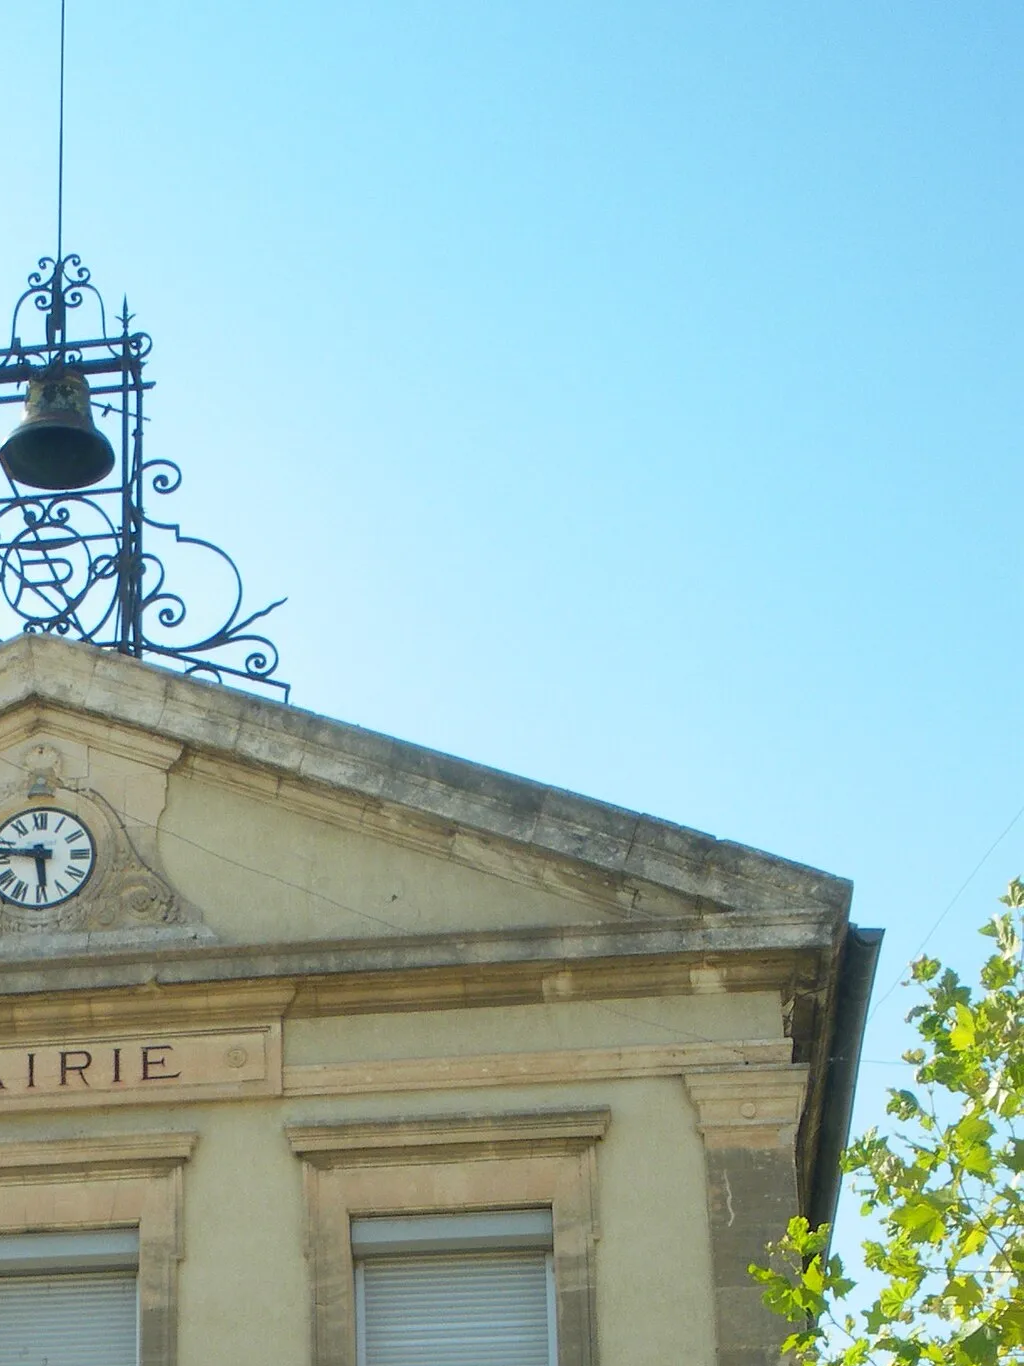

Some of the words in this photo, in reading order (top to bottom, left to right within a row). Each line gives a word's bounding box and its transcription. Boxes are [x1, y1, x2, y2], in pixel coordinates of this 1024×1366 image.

[11, 819, 29, 838] XI
[32, 812, 48, 831] XII
[64, 829, 85, 844] II
[70, 848, 90, 860] III
[65, 865, 86, 883] IV
[10, 880, 29, 902] VII
[54, 879, 69, 898] V
